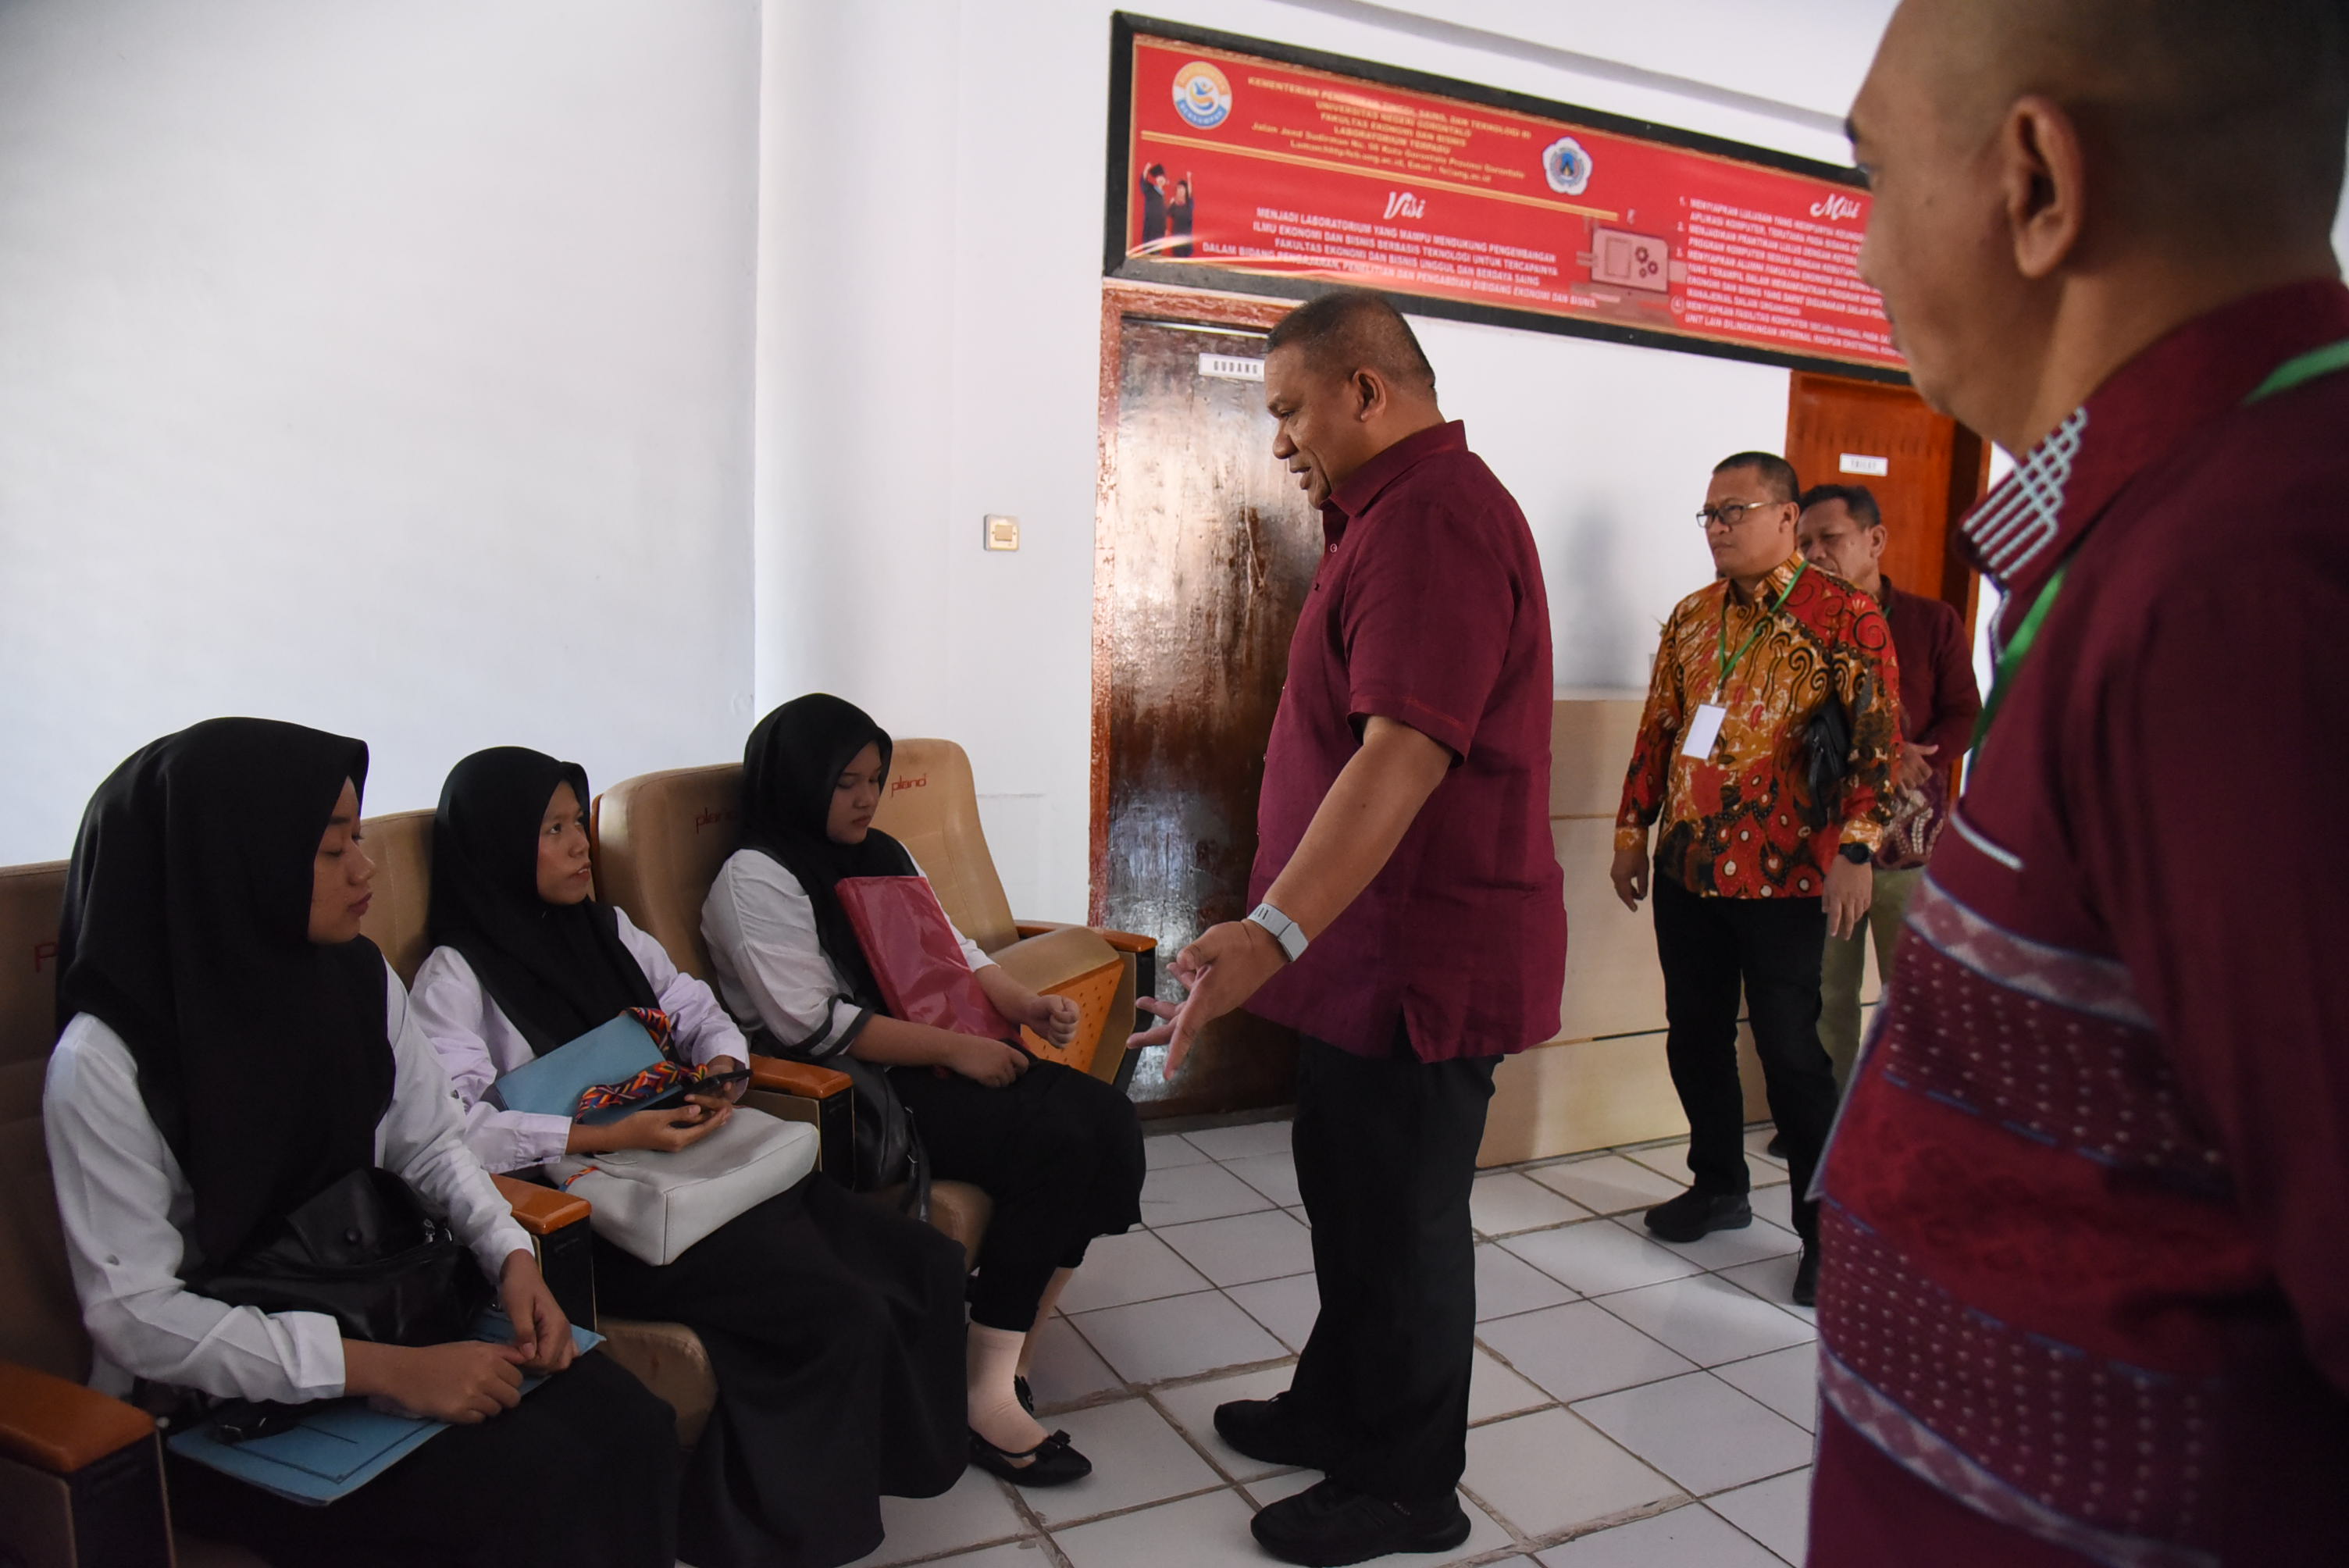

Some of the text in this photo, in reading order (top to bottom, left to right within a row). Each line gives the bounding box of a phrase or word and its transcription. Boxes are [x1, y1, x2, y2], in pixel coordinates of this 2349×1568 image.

[1248, 76, 1318, 97] KEMENTERIAN
[1316, 101, 1378, 119] UNIVERSITAS
[1417, 120, 1471, 137] GORONTALO
[1321, 111, 1368, 128] FAKULTAS
[1383, 191, 1425, 220] Visi
[1203, 241, 1236, 255] DALAM
[1256, 207, 1298, 222] MENJADI
[1300, 214, 1371, 233] LABORATORIUM
[1374, 226, 1396, 237] YANG
[1432, 235, 1487, 251] MENDUKUNG
[1488, 244, 1556, 262] PENGEMBANGAN
[1278, 225, 1321, 240] EKONOMI
[1324, 232, 1342, 243] DAN
[1346, 235, 1374, 248] BISNIS
[1378, 240, 1420, 255] BERBASIS
[1423, 247, 1470, 262] TEKNOLOGI
[1473, 255, 1501, 267] UNTUK
[1274, 237, 1321, 252] FAKULTAS
[1324, 244, 1366, 259] EKONOMI
[1368, 251, 1386, 262] DAN
[1388, 255, 1417, 266] BISNIS
[1457, 265, 1474, 275] DAN
